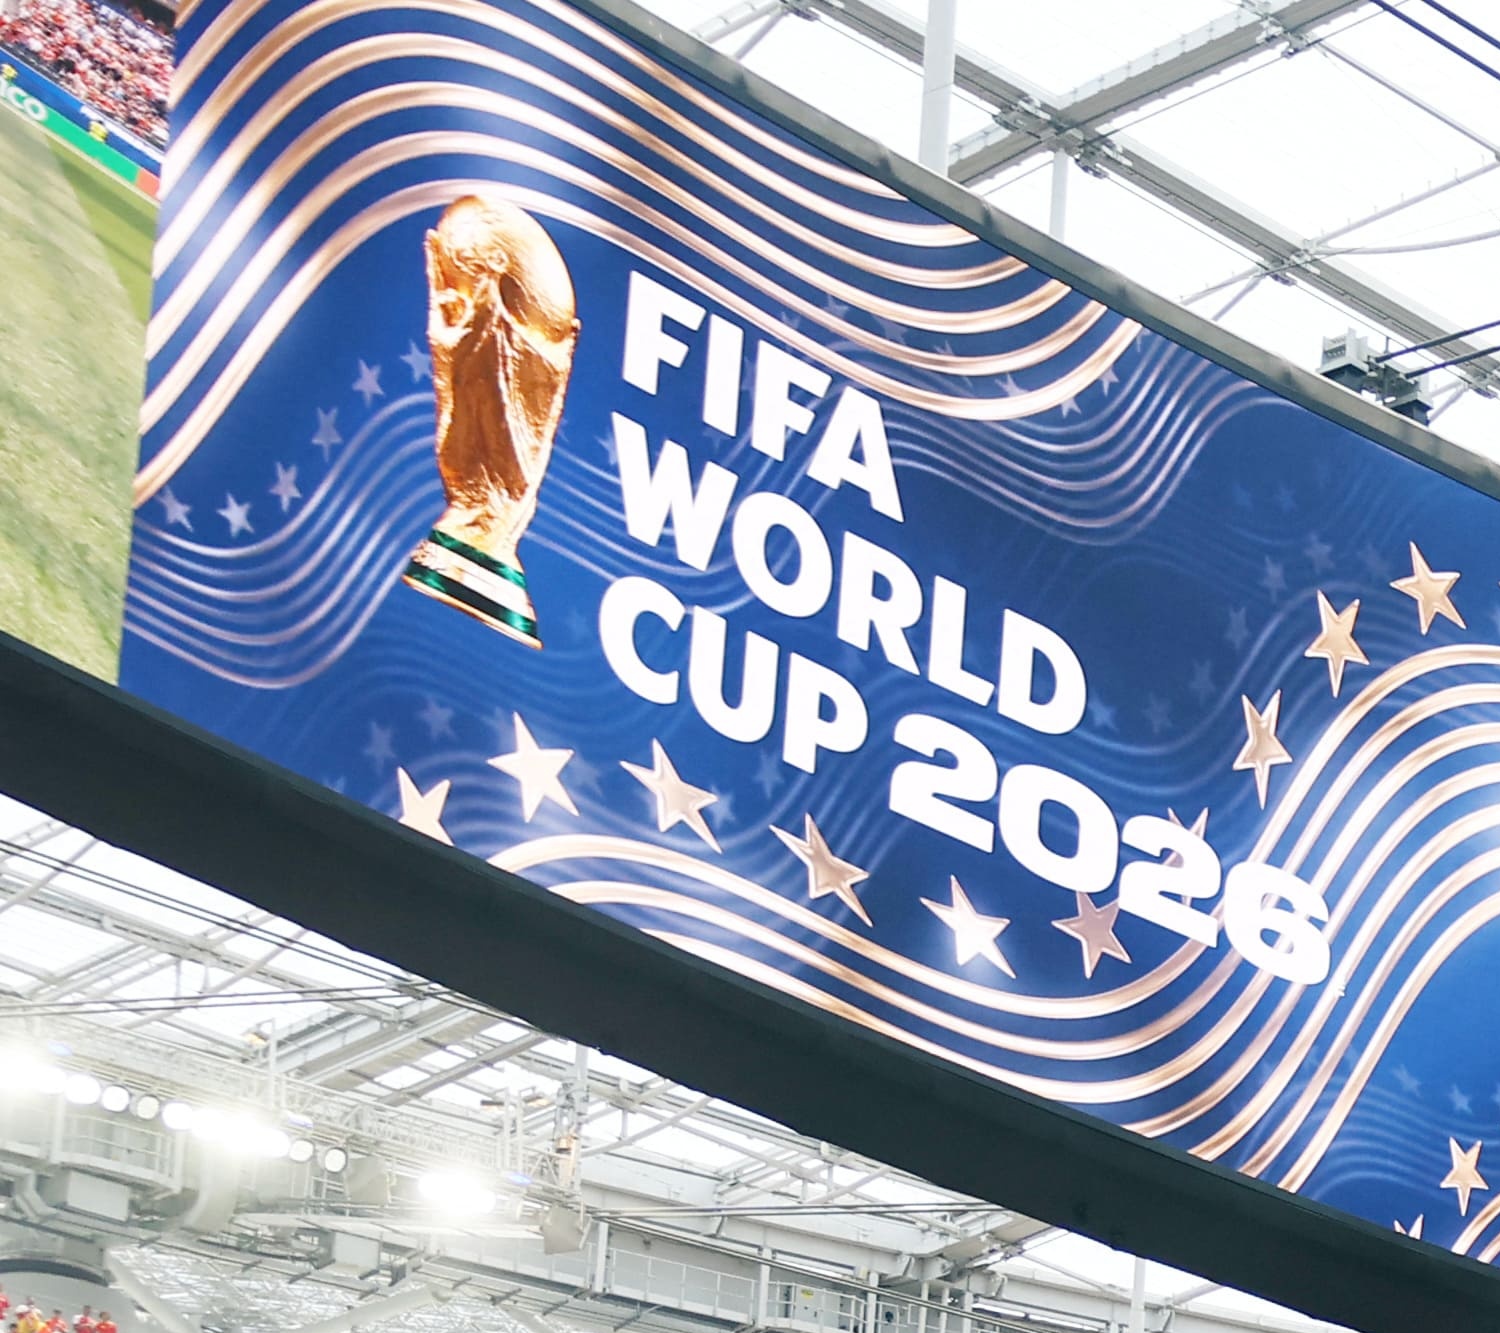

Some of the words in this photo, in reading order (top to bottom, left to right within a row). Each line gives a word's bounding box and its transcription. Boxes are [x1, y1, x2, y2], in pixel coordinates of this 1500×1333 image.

[621, 271, 903, 523] FIFA
[610, 415, 1086, 735] WORLD
[600, 575, 868, 776] CUP
[890, 715, 1334, 985] 2026
